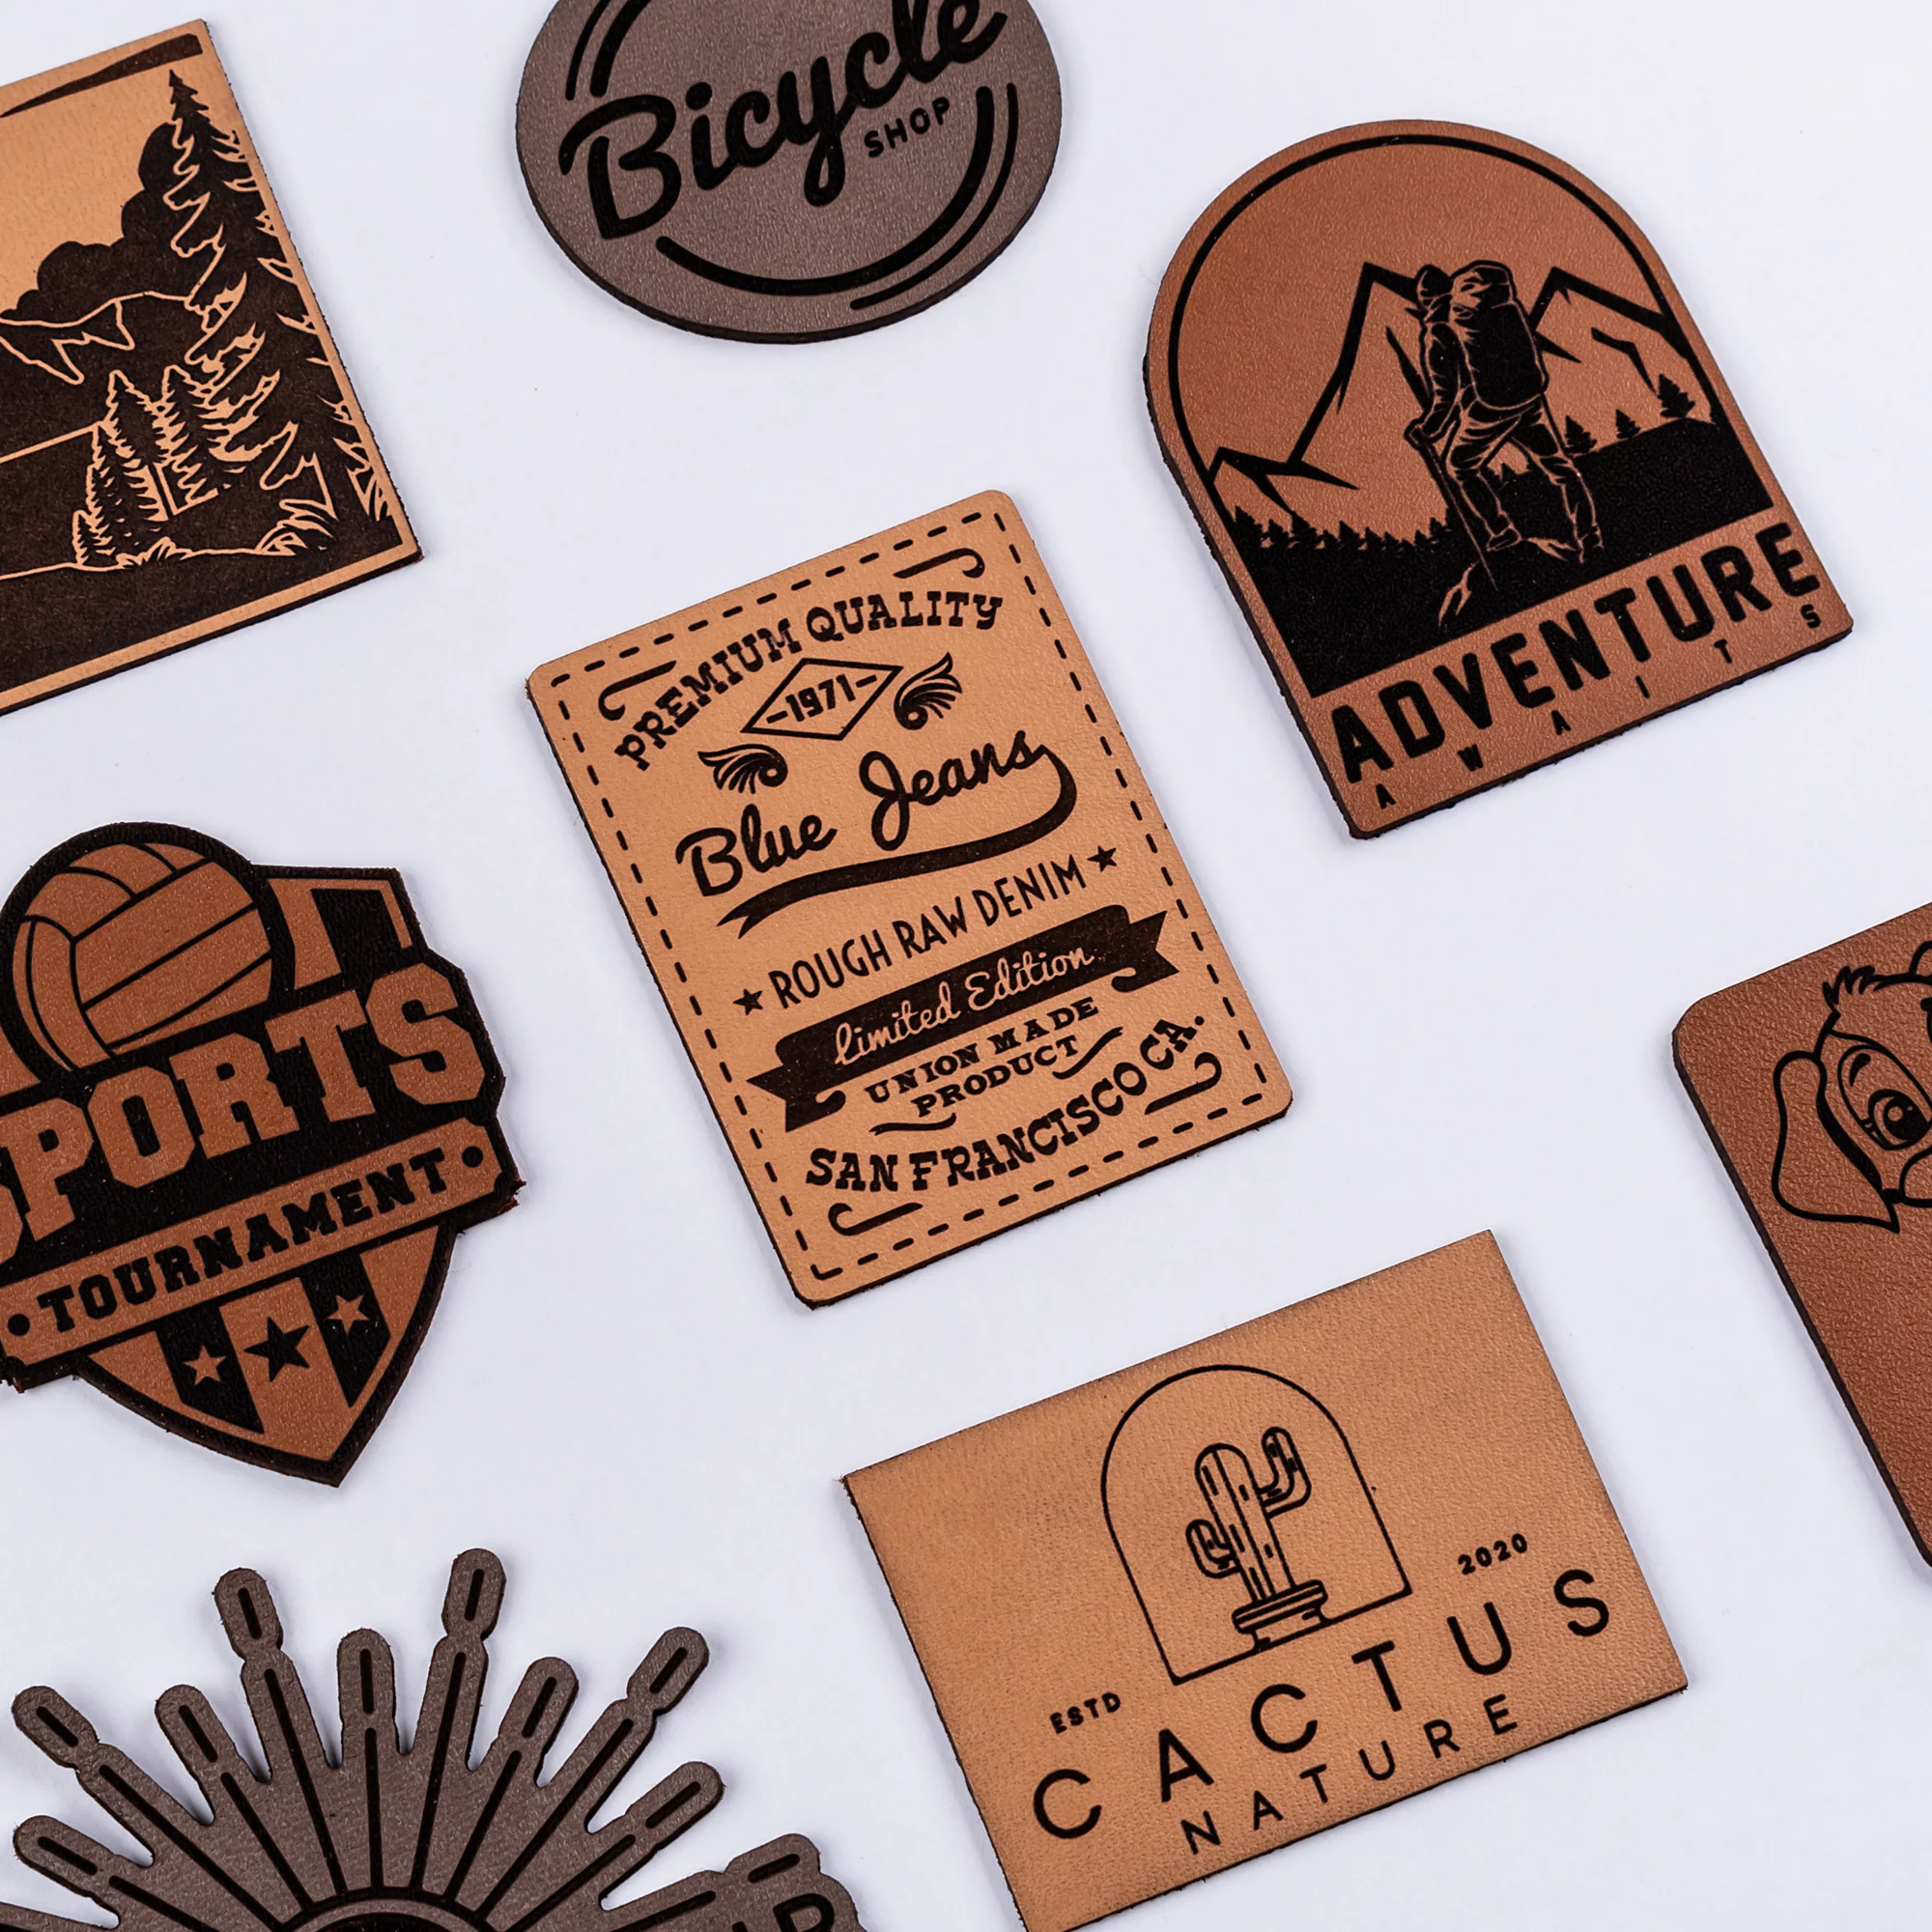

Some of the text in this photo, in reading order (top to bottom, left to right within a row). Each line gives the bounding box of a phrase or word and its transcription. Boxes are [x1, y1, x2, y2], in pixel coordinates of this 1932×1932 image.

[557, 0, 1008, 240] Bicycle
[863, 96, 951, 157] SHOP
[613, 590, 1003, 771] PREMIUM QUALITY
[1330, 522, 1821, 784] ADVENTURE
[675, 730, 1047, 896] Blue Jeans
[768, 854, 1087, 1009] ROUGH RAW DENIM
[965, 946, 1095, 1011] Edition
[0, 962, 485, 1265] PORTS
[805, 1015, 1205, 1192] SAN FRANCISCO CA.
[864, 996, 1099, 1103] UNION MADE
[911, 1035, 1080, 1118] PRODUCT
[37, 1147, 447, 1333] TOURNAMENT
[1457, 1533, 1528, 1576] 2020
[1033, 1569, 1610, 1839] CACTUS
[1049, 1691, 1122, 1735] ESTD
[1181, 1693, 1518, 1854] NATURE
